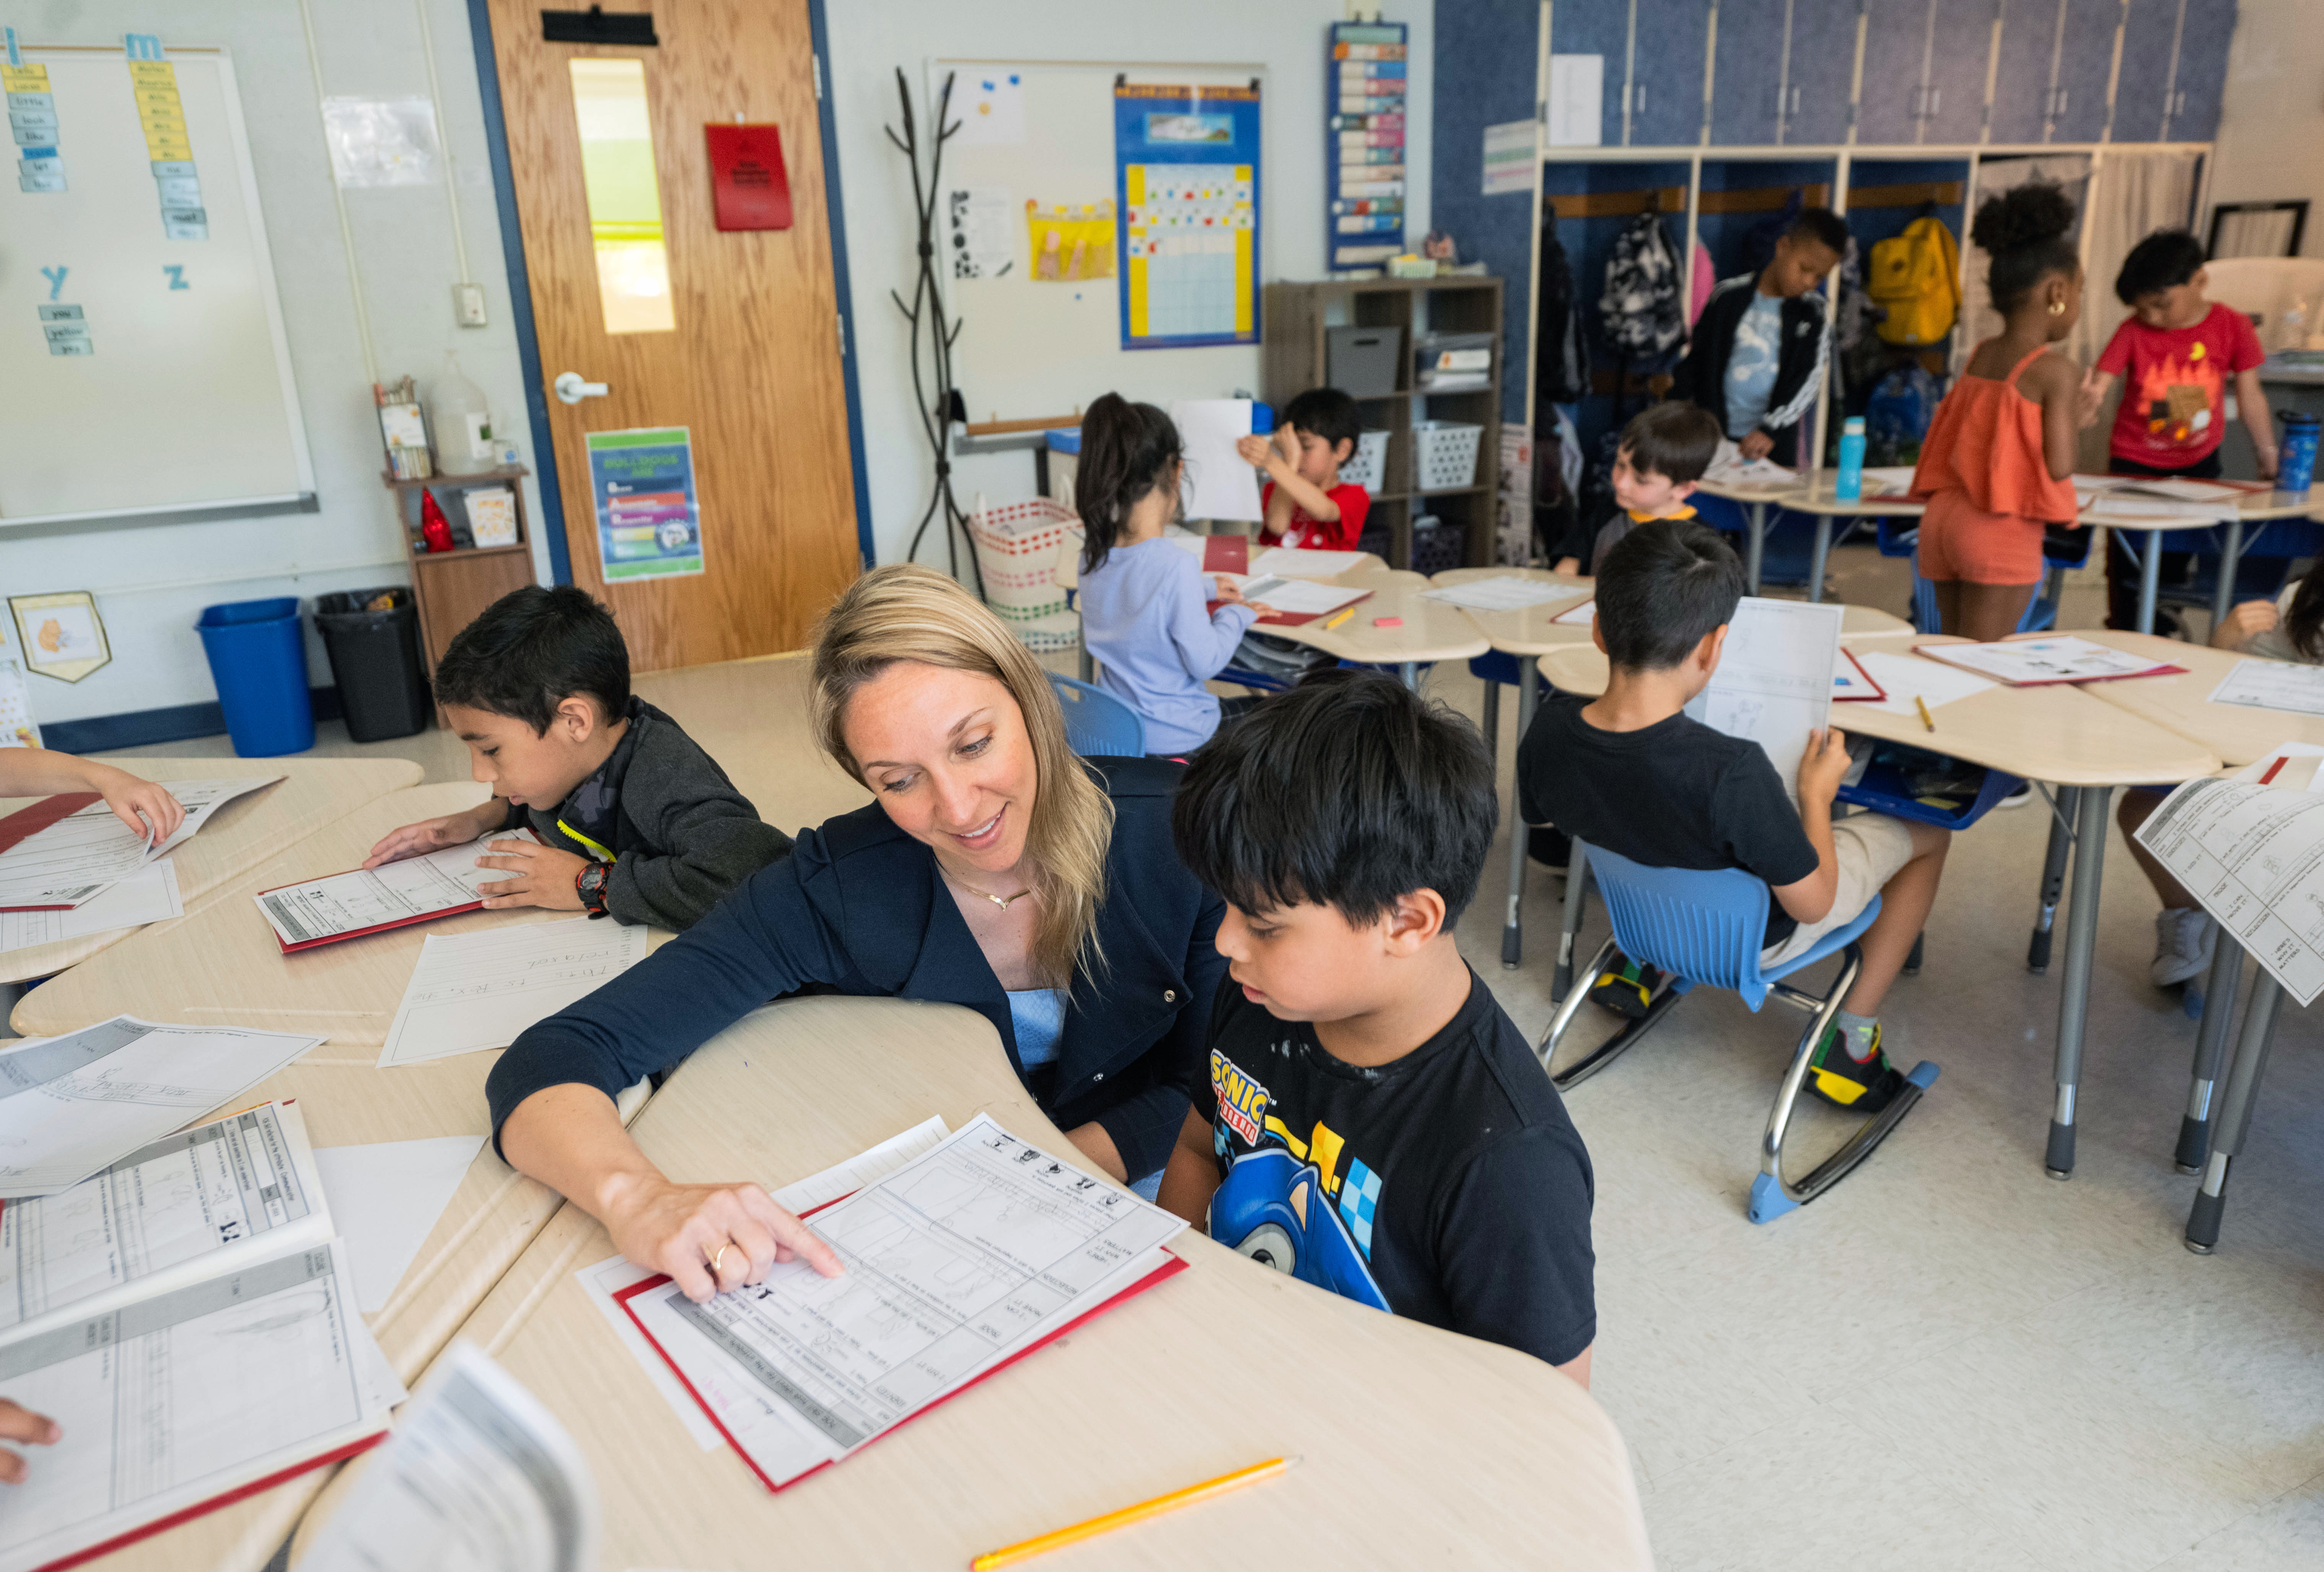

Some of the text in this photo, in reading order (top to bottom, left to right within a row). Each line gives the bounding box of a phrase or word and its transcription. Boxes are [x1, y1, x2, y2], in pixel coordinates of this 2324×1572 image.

[126, 33, 163, 61] m
[161, 263, 191, 291] z
[2186, 859, 2197, 870] DID
[2195, 853, 2203, 861] IT
[2212, 881, 2228, 898] PROOF
[2232, 893, 2244, 905] CAN
[2226, 898, 2248, 920] PROVE IT
[2244, 911, 2271, 939] REFLECTION
[2274, 936, 2291, 955] HERE'S
[2277, 942, 2295, 962] WHY IT
[2278, 946, 2301, 971] MATTERS
[1211, 1053, 1269, 1126] SONIC
[1222, 1102, 1256, 1142] DGEHOG
[240, 1170, 251, 1191] understand
[280, 1171, 296, 1202] Communicator
[991, 1243, 1013, 1259] important
[1085, 1247, 1108, 1266] HERE'S
[1093, 1242, 1120, 1261] WHY IT
[1103, 1235, 1133, 1259] MATTERS
[1041, 1269, 1078, 1297] REFLECTION
[1003, 1302, 1021, 1316] CAN
[1012, 1296, 1044, 1318] PROVE IT
[978, 1321, 1002, 1341] PROOF
[915, 1358, 928, 1370] IT
[925, 1364, 941, 1378] DID
